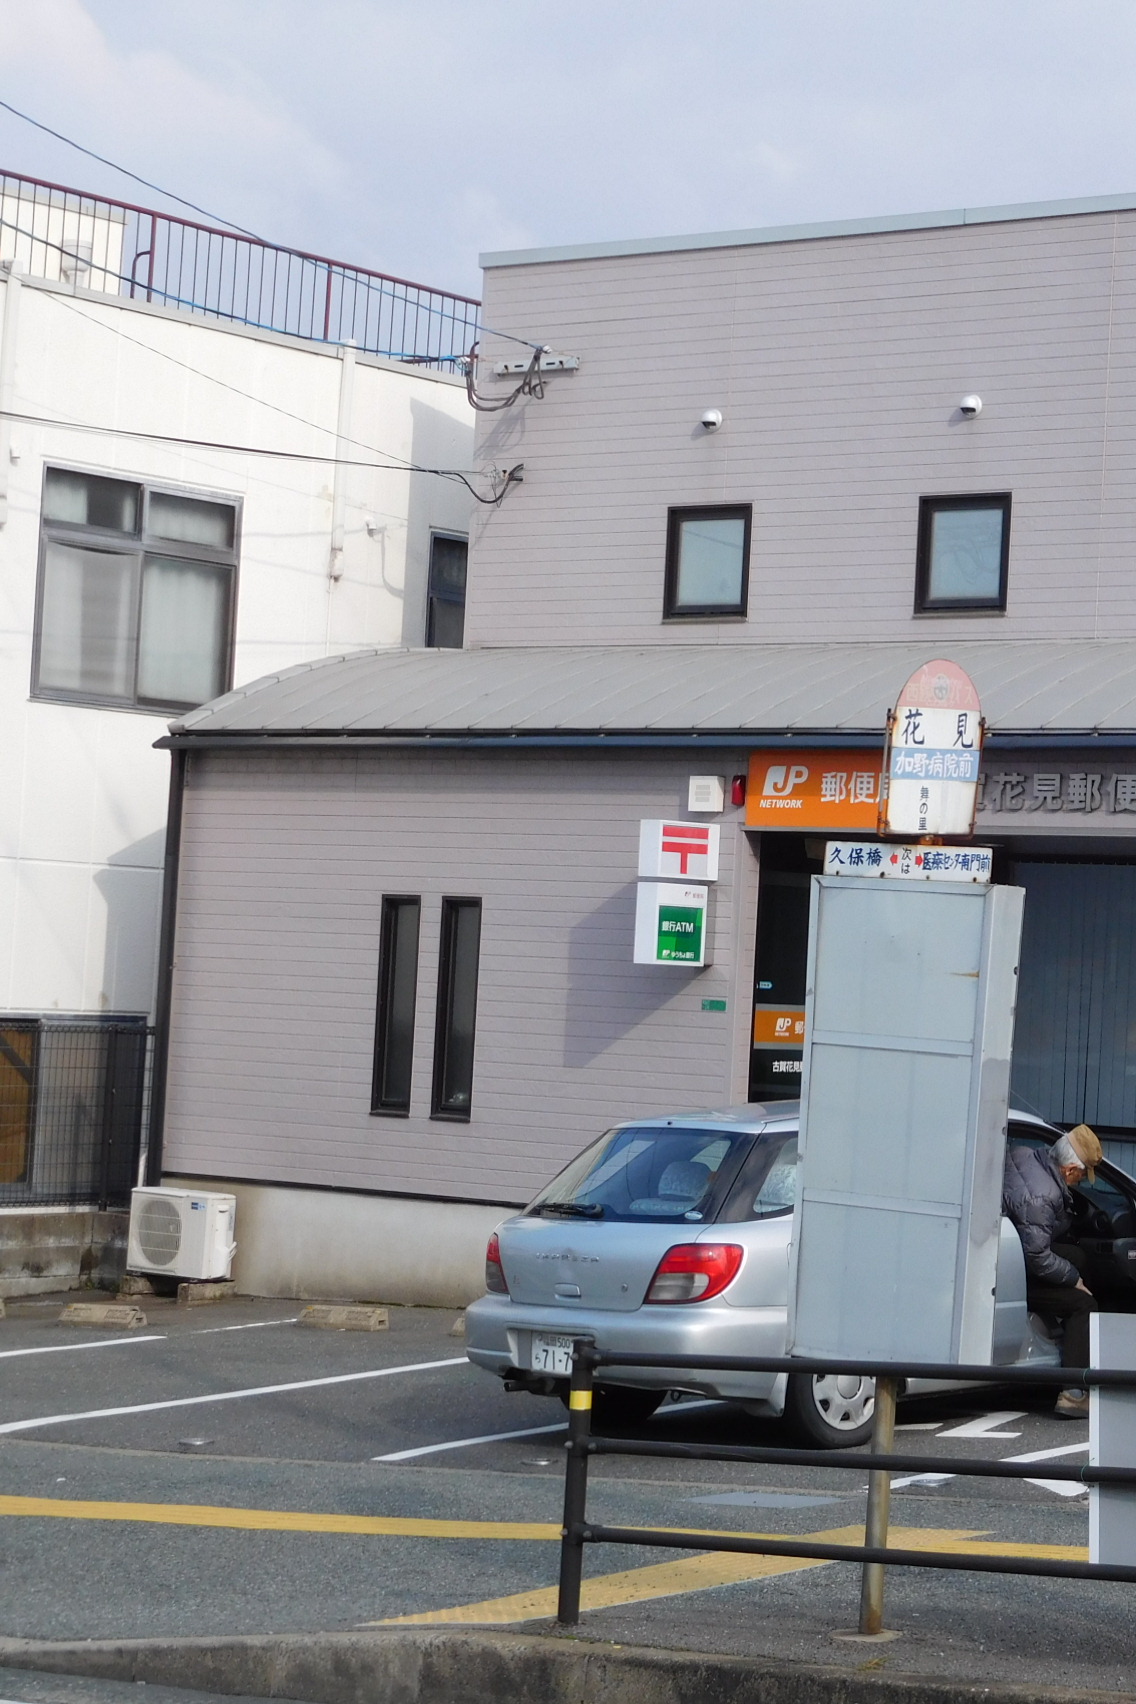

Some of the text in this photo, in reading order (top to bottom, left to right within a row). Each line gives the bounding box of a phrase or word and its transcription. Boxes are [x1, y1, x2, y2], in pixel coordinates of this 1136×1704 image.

[902, 708, 974, 749] 花見
[894, 751, 974, 778] 加野病院前
[759, 799, 803, 809] NETWORK
[918, 785, 930, 831] 舞の里
[828, 846, 884, 867] 久保橋
[900, 847, 912, 875] 次は
[661, 920, 694, 933] 銀行ATM
[557, 1337, 571, 1349] 500
[542, 1348, 571, 1372] 71-7
